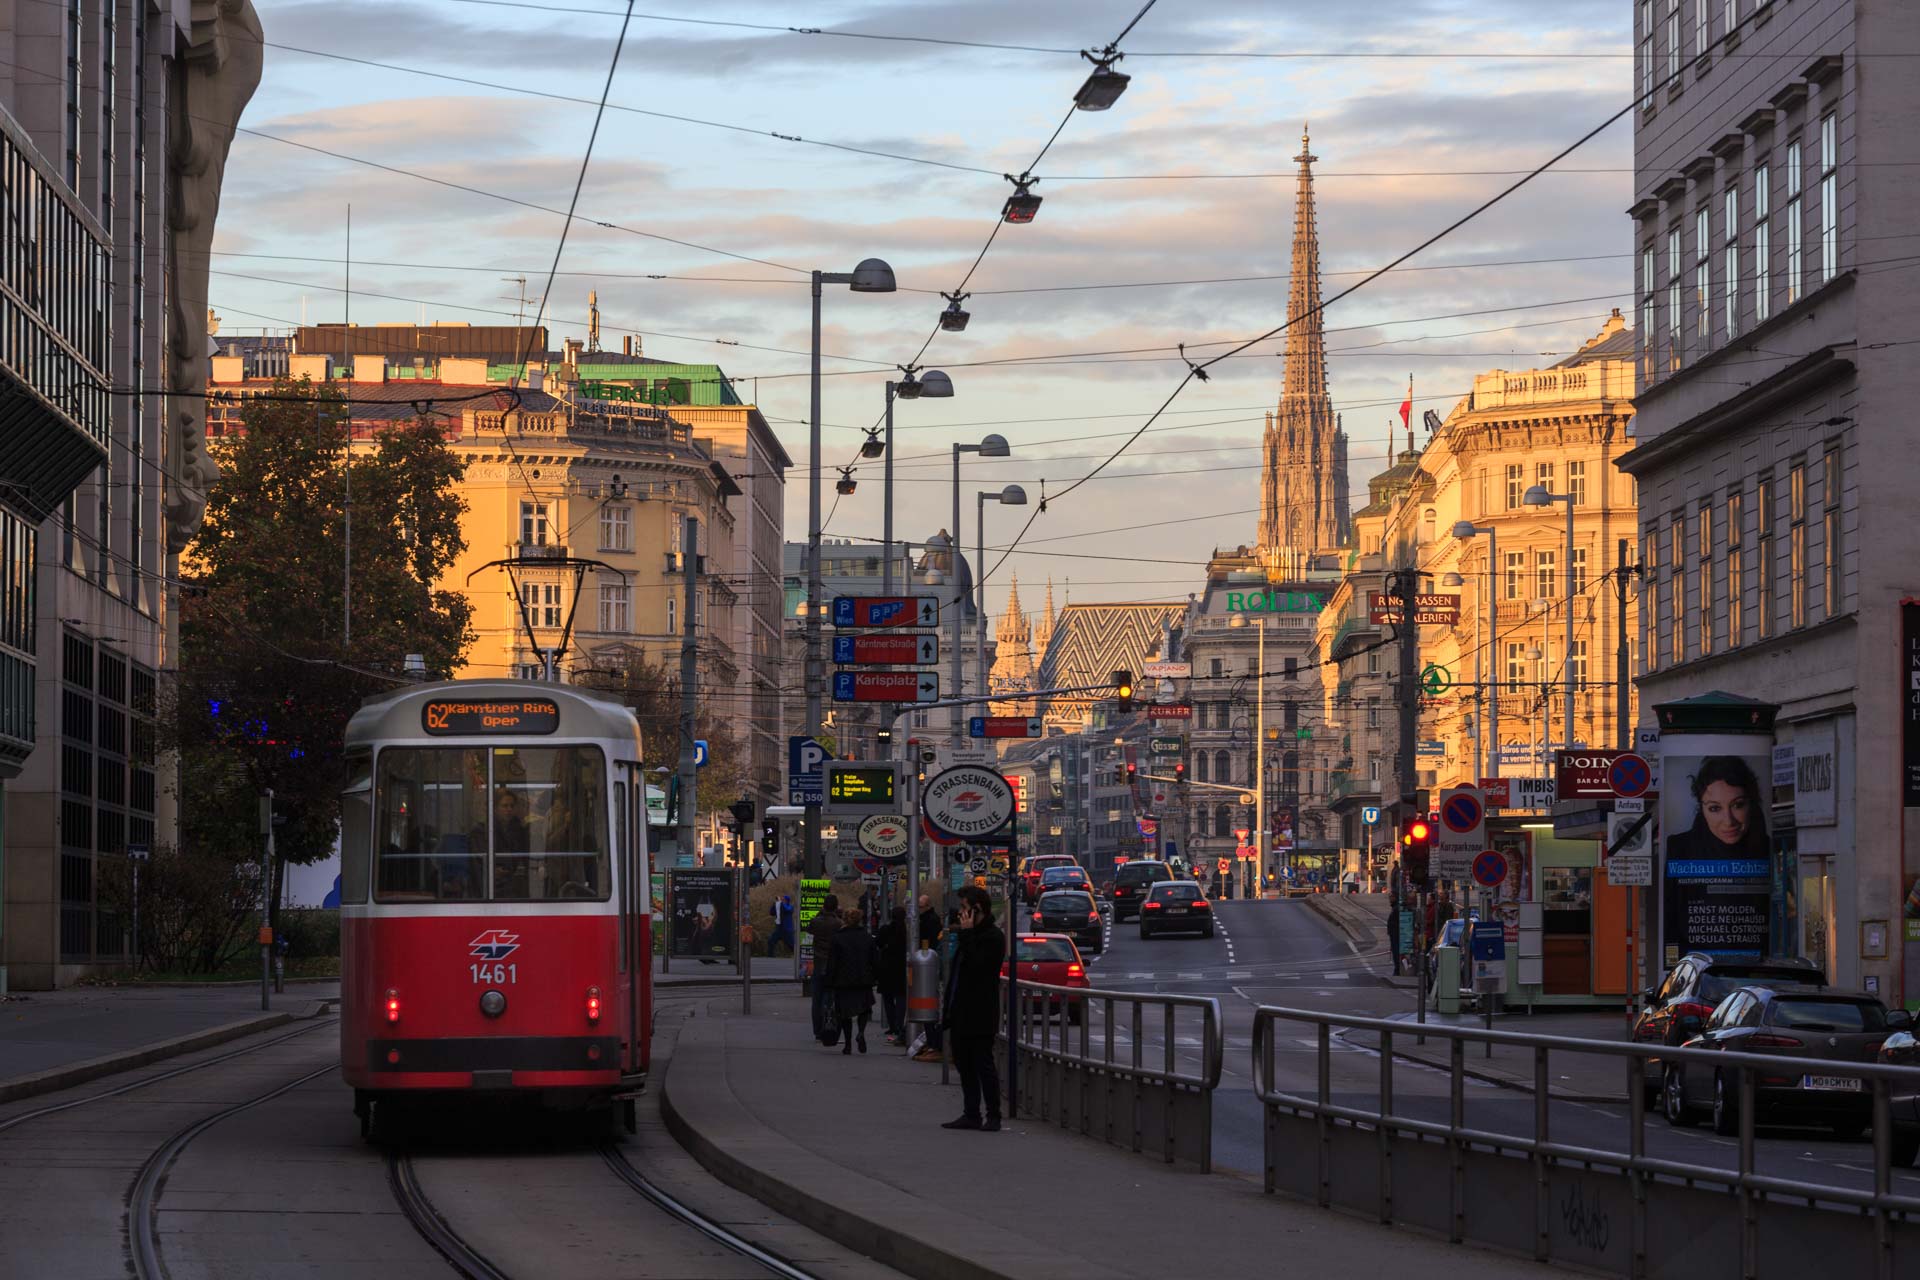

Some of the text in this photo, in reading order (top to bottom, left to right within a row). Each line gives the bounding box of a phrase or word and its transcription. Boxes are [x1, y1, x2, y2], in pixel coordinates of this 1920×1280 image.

[579, 382, 672, 406] MERKUR
[579, 401, 670, 419] VERSICHERUNG
[1226, 591, 1325, 612] ROLEX
[1378, 595, 1452, 606] RNGRASSEN
[836, 616, 854, 625] Wien
[856, 639, 916, 649] Kärntner Straße
[856, 674, 917, 687] Karlsplatz
[427, 703, 556, 728] 62 Kärntner Ring
[1150, 707, 1191, 716] KURIER
[482, 715, 520, 728] Oper
[1501, 744, 1518, 754] Büros
[835, 774, 840, 784] 1
[887, 775, 893, 784] 4
[831, 786, 841, 796] 62
[932, 774, 1005, 800] STRASSENBAHN
[805, 793, 823, 802] 350
[1618, 801, 1642, 811] Anfang
[936, 811, 1002, 832] HALTESTELLE
[1369, 810, 1377, 823] U
[1440, 842, 1483, 853] Kurzparkzone
[957, 849, 966, 861] 1
[971, 861, 986, 872] 62
[1667, 862, 1715, 874] Wachau
[1717, 862, 1729, 873] in
[1687, 905, 1756, 914] ERNST MOLDEN
[1687, 914, 1766, 924] ADELE NEUHAUSER
[1687, 925, 1730, 934] MICHAEL
[1687, 935, 1761, 944] URSULA STRAUSS
[469, 963, 517, 984] 1461
